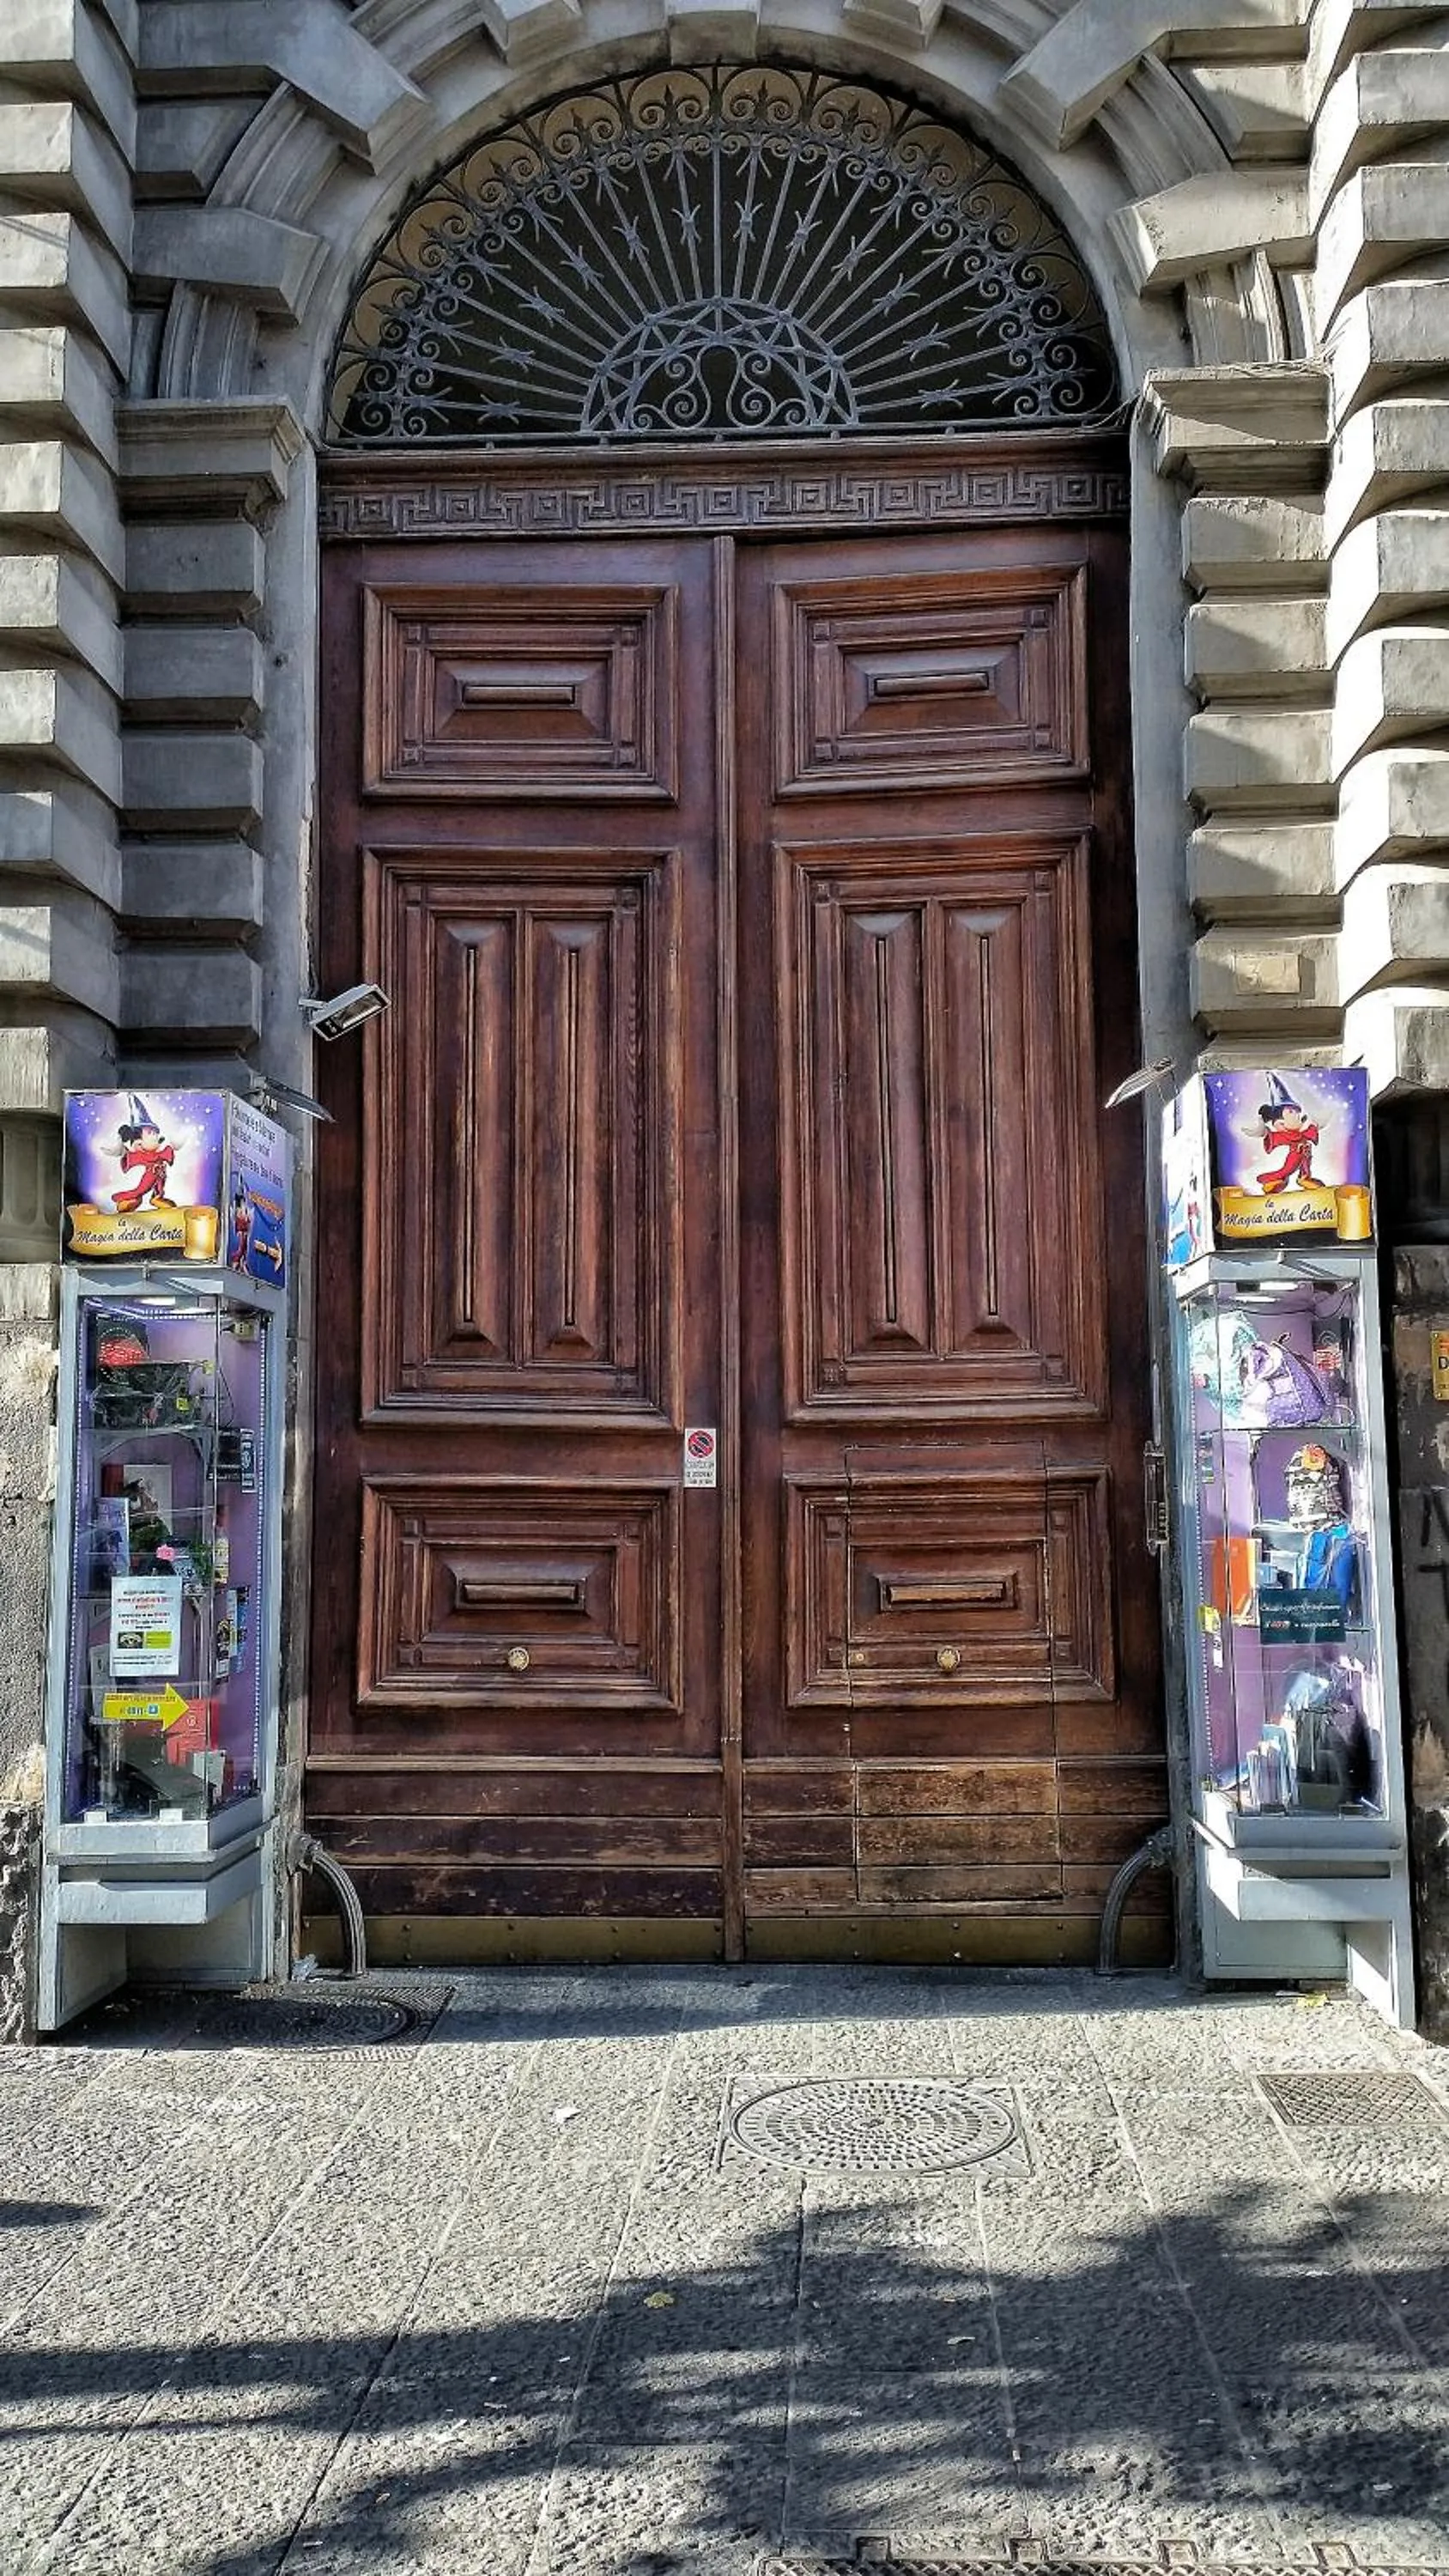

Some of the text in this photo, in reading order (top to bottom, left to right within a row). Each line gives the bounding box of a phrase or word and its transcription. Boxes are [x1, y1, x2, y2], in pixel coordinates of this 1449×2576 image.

[1224, 1203, 1333, 1228] Magia della Carta
[76, 1224, 183, 1245] Magia della Carta
